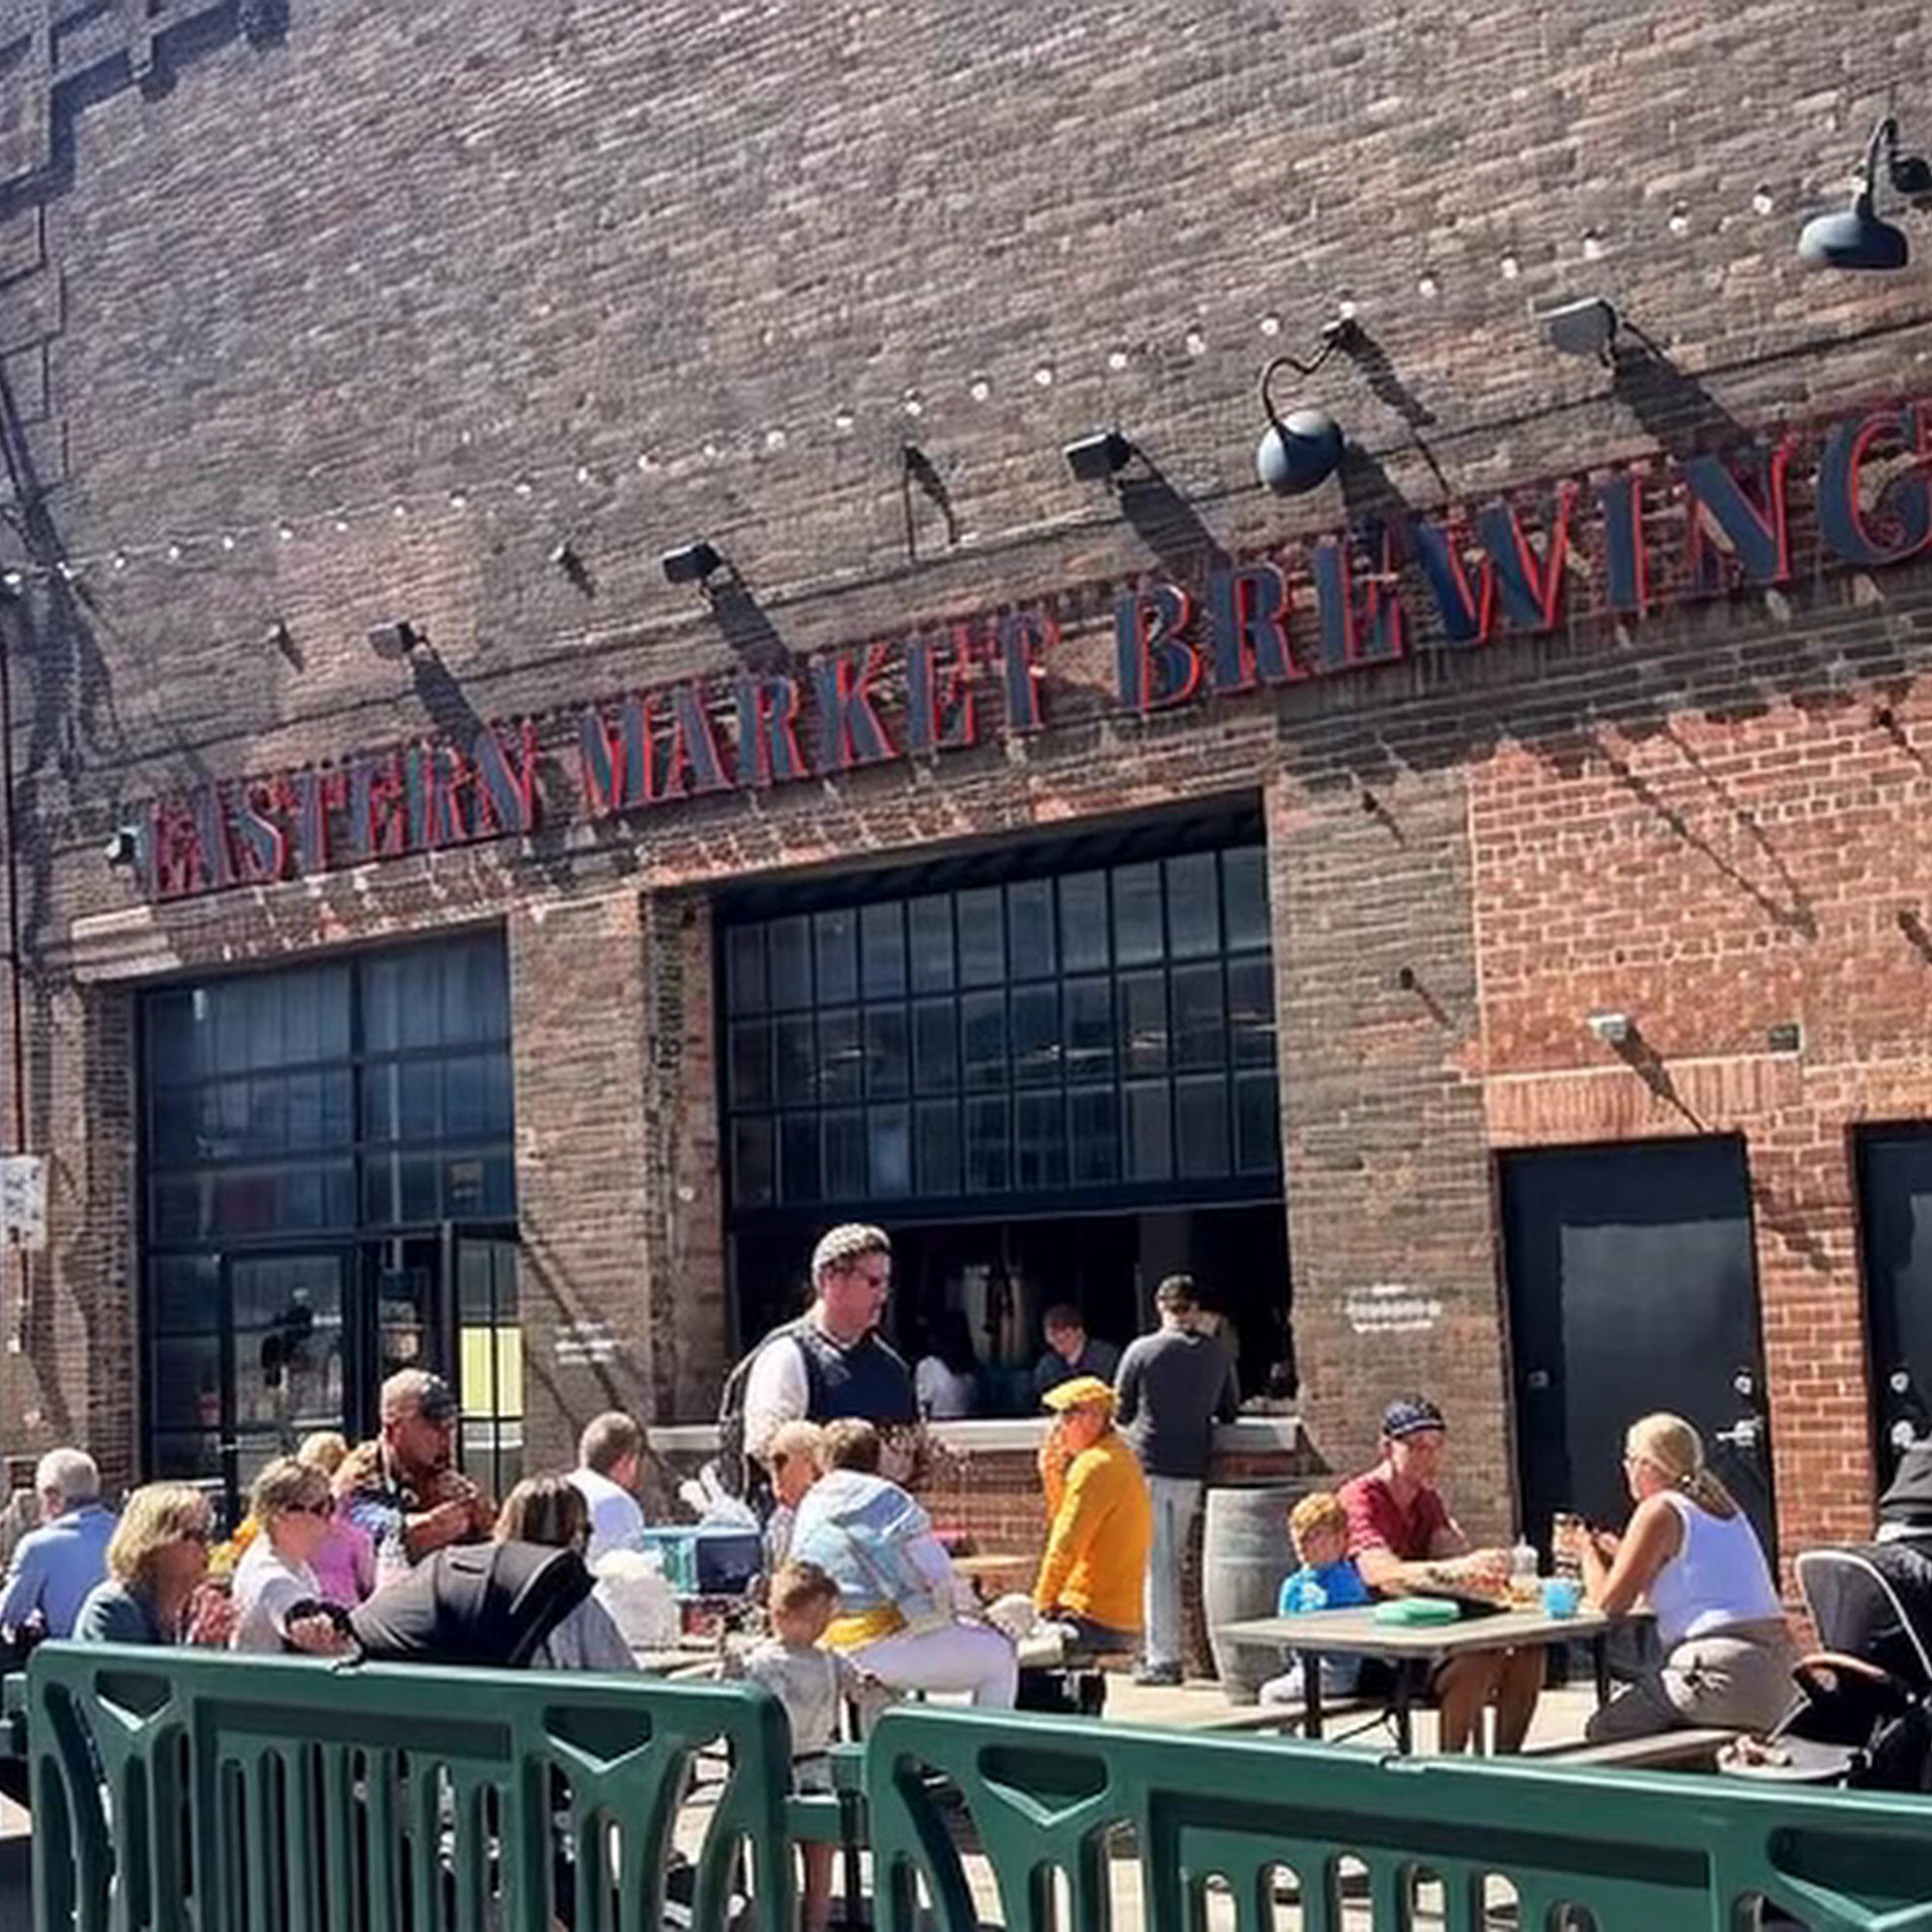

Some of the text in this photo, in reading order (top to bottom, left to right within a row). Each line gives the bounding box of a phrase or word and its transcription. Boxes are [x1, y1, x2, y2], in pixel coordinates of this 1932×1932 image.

[139, 396, 1932, 902] EASTERN MARKET BREWING
